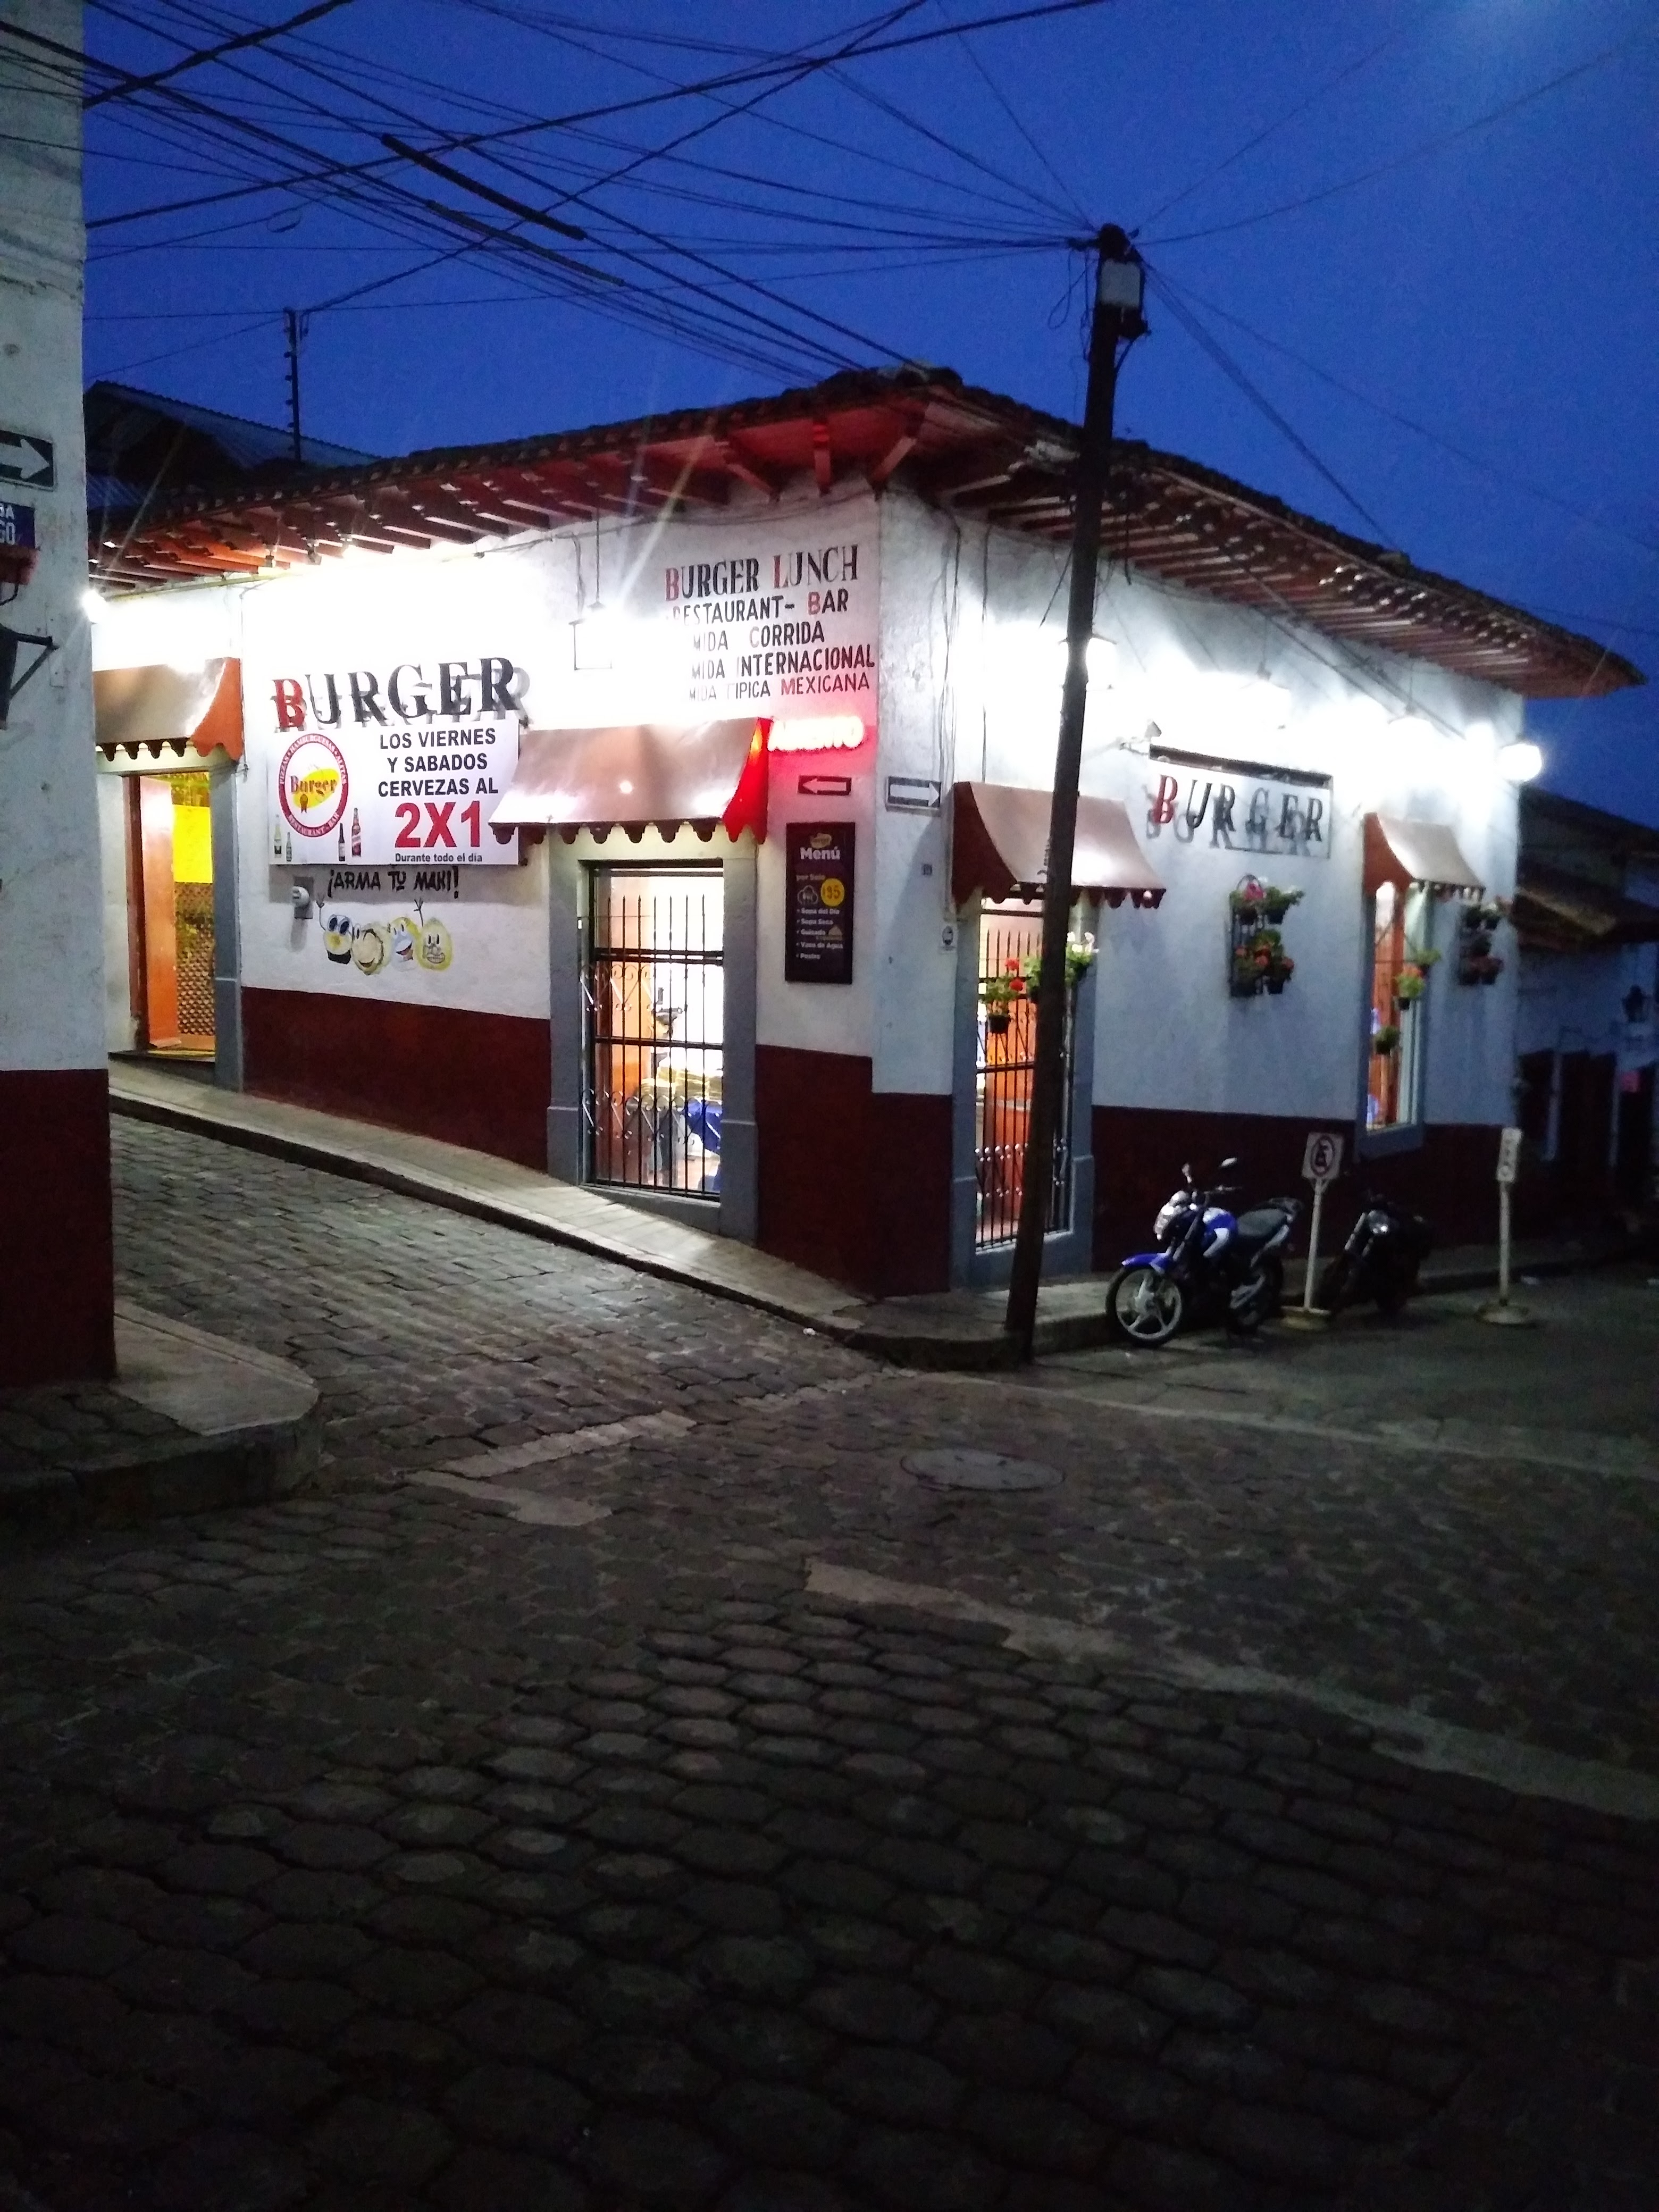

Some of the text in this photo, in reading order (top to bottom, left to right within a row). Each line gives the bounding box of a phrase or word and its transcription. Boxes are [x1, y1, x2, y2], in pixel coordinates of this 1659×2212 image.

[665, 544, 858, 601] BURGER LUNCH
[808, 588, 849, 615] BAR
[749, 621, 825, 648] CORRIDA
[736, 644, 875, 677] INTERNACIONAL
[270, 657, 520, 728] BURGER
[780, 672, 870, 696] MEXICANA
[380, 727, 496, 749] LOS VIERNES
[387, 752, 488, 773] Y SABADOS
[291, 775, 337, 797] Burger
[378, 777, 499, 797] CERVEZAS AL
[1151, 774, 1323, 842] BURGER
[395, 800, 480, 848] 2X1
[395, 853, 431, 862] Durante
[434, 853, 454, 862] todo
[457, 853, 465, 862] el
[327, 869, 381, 898] ¡ARMA
[413, 865, 459, 899] MAKI!
